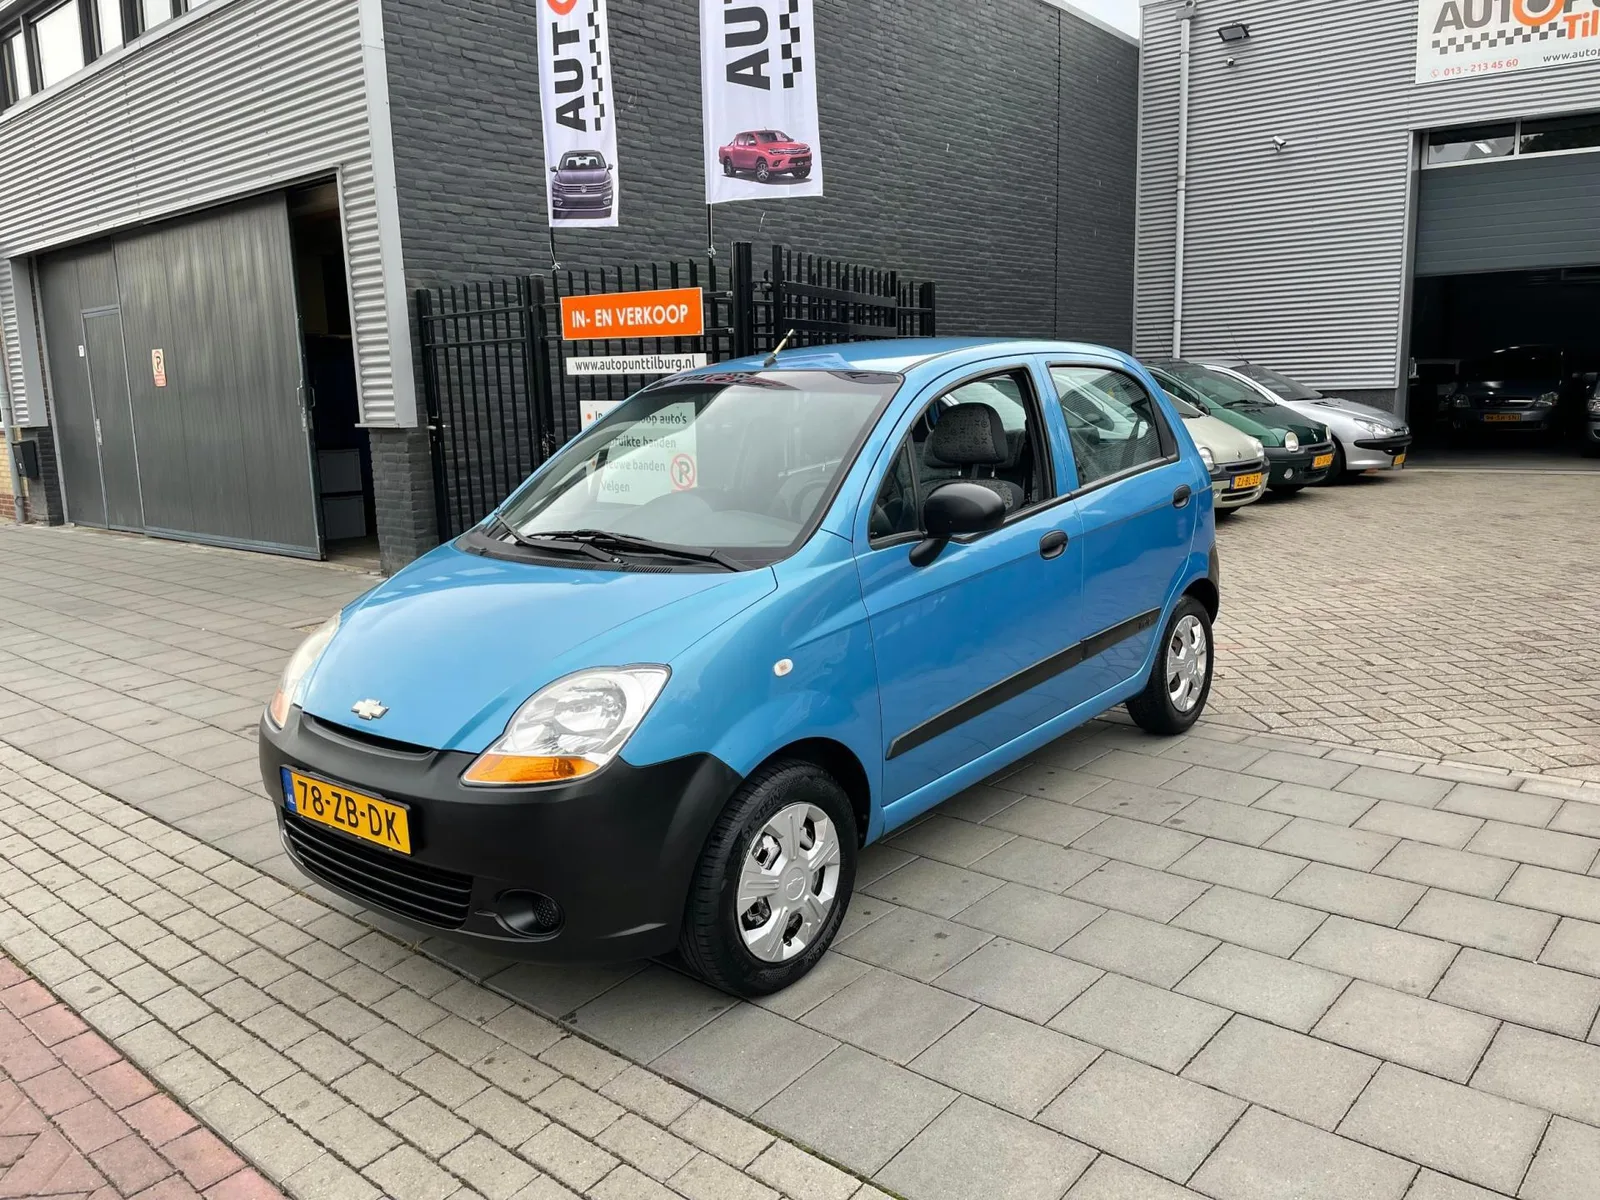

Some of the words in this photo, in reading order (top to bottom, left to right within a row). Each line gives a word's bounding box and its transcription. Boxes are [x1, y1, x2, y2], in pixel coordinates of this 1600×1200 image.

[1433, 0, 1600, 34] AUTO
[723, 0, 771, 91] AU
[1443, 67, 1461, 77] 013
[1470, 63, 1489, 73] 213
[1491, 60, 1503, 70] 45
[1506, 58, 1519, 68] 60
[572, 311, 590, 328] IN-
[595, 308, 612, 327] EN
[616, 304, 688, 326] VERKOOP
[575, 356, 695, 373] www.autopunttilburg.nl
[660, 412, 687, 424] auto's
[633, 459, 665, 471] banden
[601, 481, 630, 493] Velgen
[297, 780, 401, 845] 78-ZB-DK
